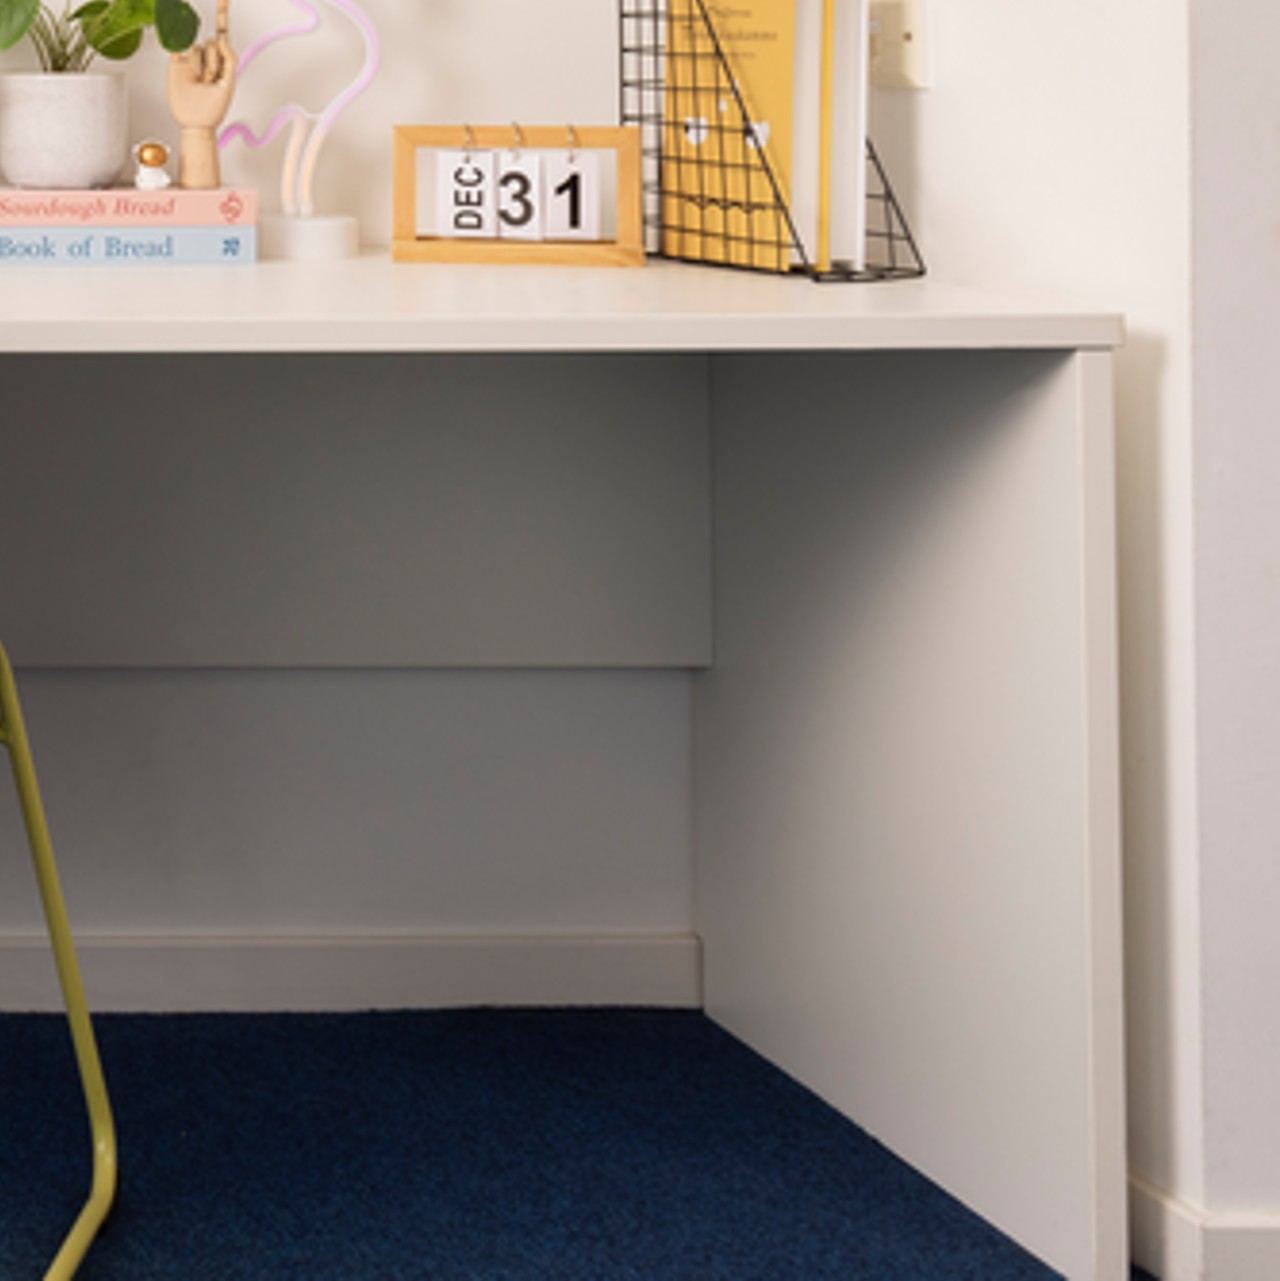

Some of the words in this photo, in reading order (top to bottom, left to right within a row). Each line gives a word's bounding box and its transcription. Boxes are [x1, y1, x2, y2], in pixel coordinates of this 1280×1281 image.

[113, 197, 176, 217] Bread
[453, 167, 484, 230] DEC
[67, 236, 93, 259] of
[104, 236, 175, 259] Bread
